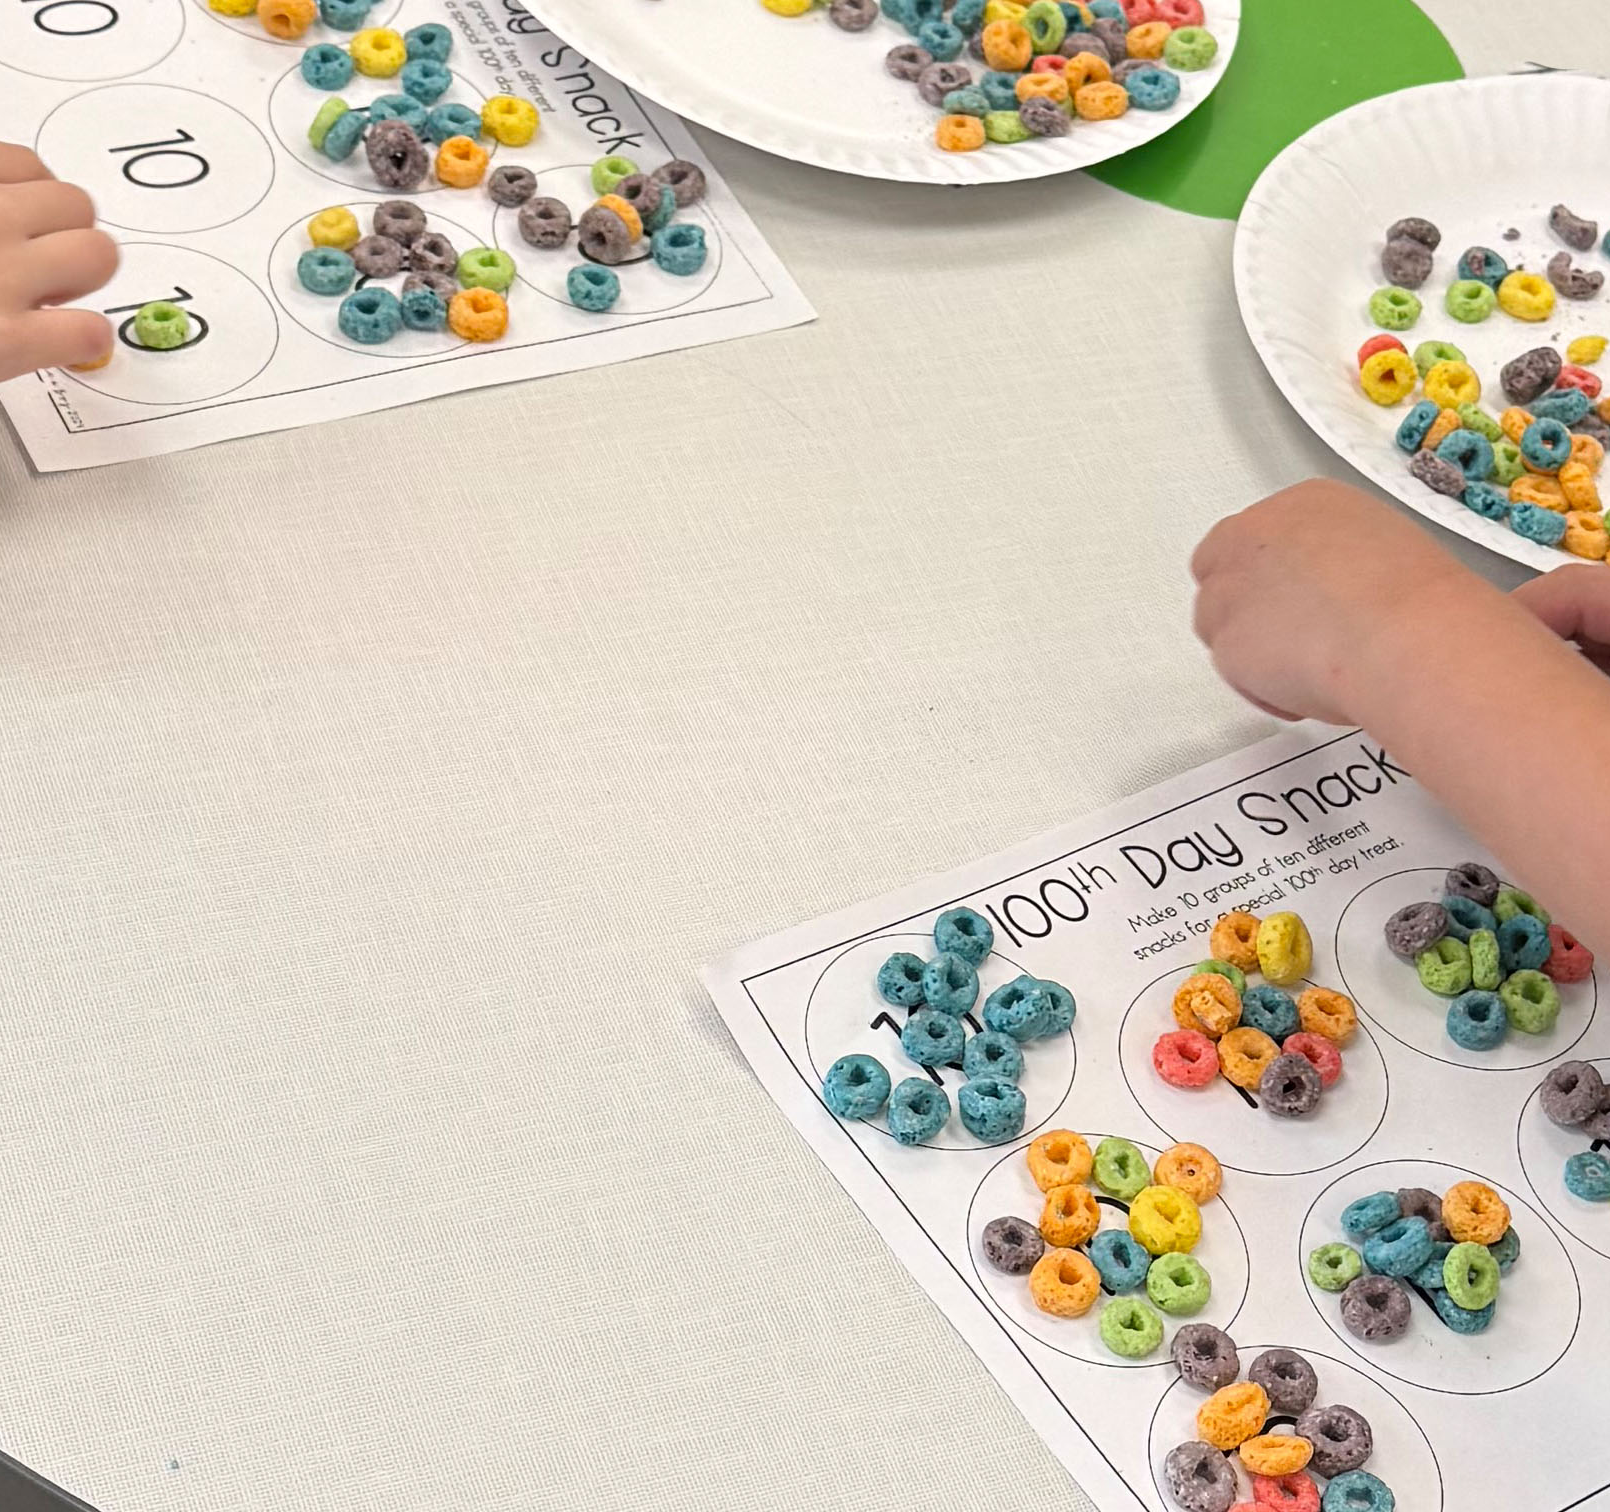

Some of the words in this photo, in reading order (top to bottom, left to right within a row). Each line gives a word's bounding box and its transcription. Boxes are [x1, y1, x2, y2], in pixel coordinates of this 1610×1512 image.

[451, 10, 488, 45] special
[466, 0, 501, 34] groups
[108, 128, 211, 190] 10
[985, 862, 1117, 949] 100th
[1120, 822, 1244, 890] Day
[1236, 743, 1412, 836] Snack
[1127, 904, 1177, 934] Make
[1177, 892, 1200, 911] 10
[1203, 871, 1256, 905] groups
[1257, 857, 1275, 877] of
[1275, 847, 1307, 870] ten
[1306, 820, 1372, 855] different
[1133, 929, 1187, 961] snacks
[1186, 914, 1214, 937] for
[1328, 852, 1360, 878] day
[1359, 838, 1406, 860] treat.
